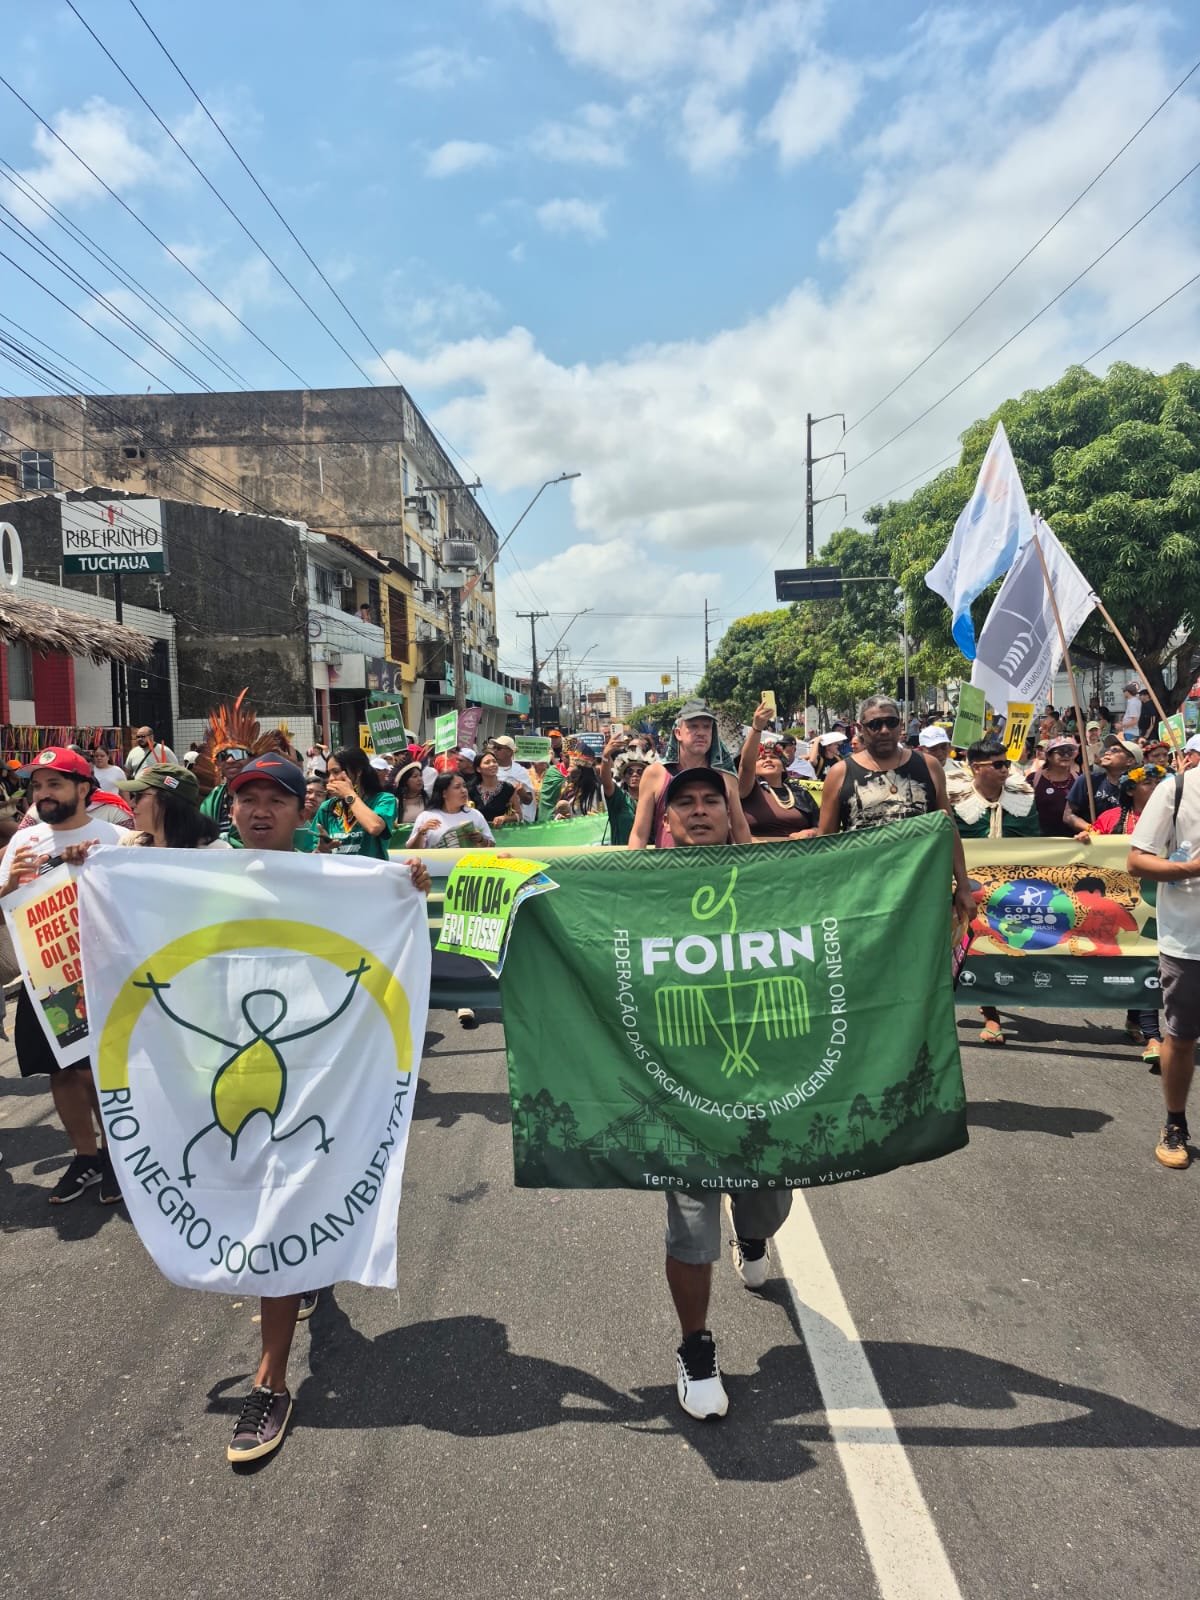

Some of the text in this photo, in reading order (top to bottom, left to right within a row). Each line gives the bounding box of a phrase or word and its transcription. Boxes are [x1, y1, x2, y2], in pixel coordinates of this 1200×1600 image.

[78, 555, 150, 571] TUCHAUA
[371, 718, 401, 732] FUTURO
[1006, 719, 1027, 750] JÁ!
[453, 875, 506, 915] FIM DA
[1004, 906, 1054, 914] COIAB
[35, 913, 70, 947] FREE
[440, 910, 505, 954] ERA FÓSSIL
[40, 942, 68, 969] OIL
[641, 924, 815, 976] FOIRN
[614, 916, 848, 1122] FEDERAÇÃO DAS ORGANIZAÇÕES INDÍGENAS DO RIO NEGRO
[100, 1071, 412, 1275] RIO NEGRO SOCIOAMBIENTAL
[642, 1167, 868, 1189] Terra, cultura e bem viver.
